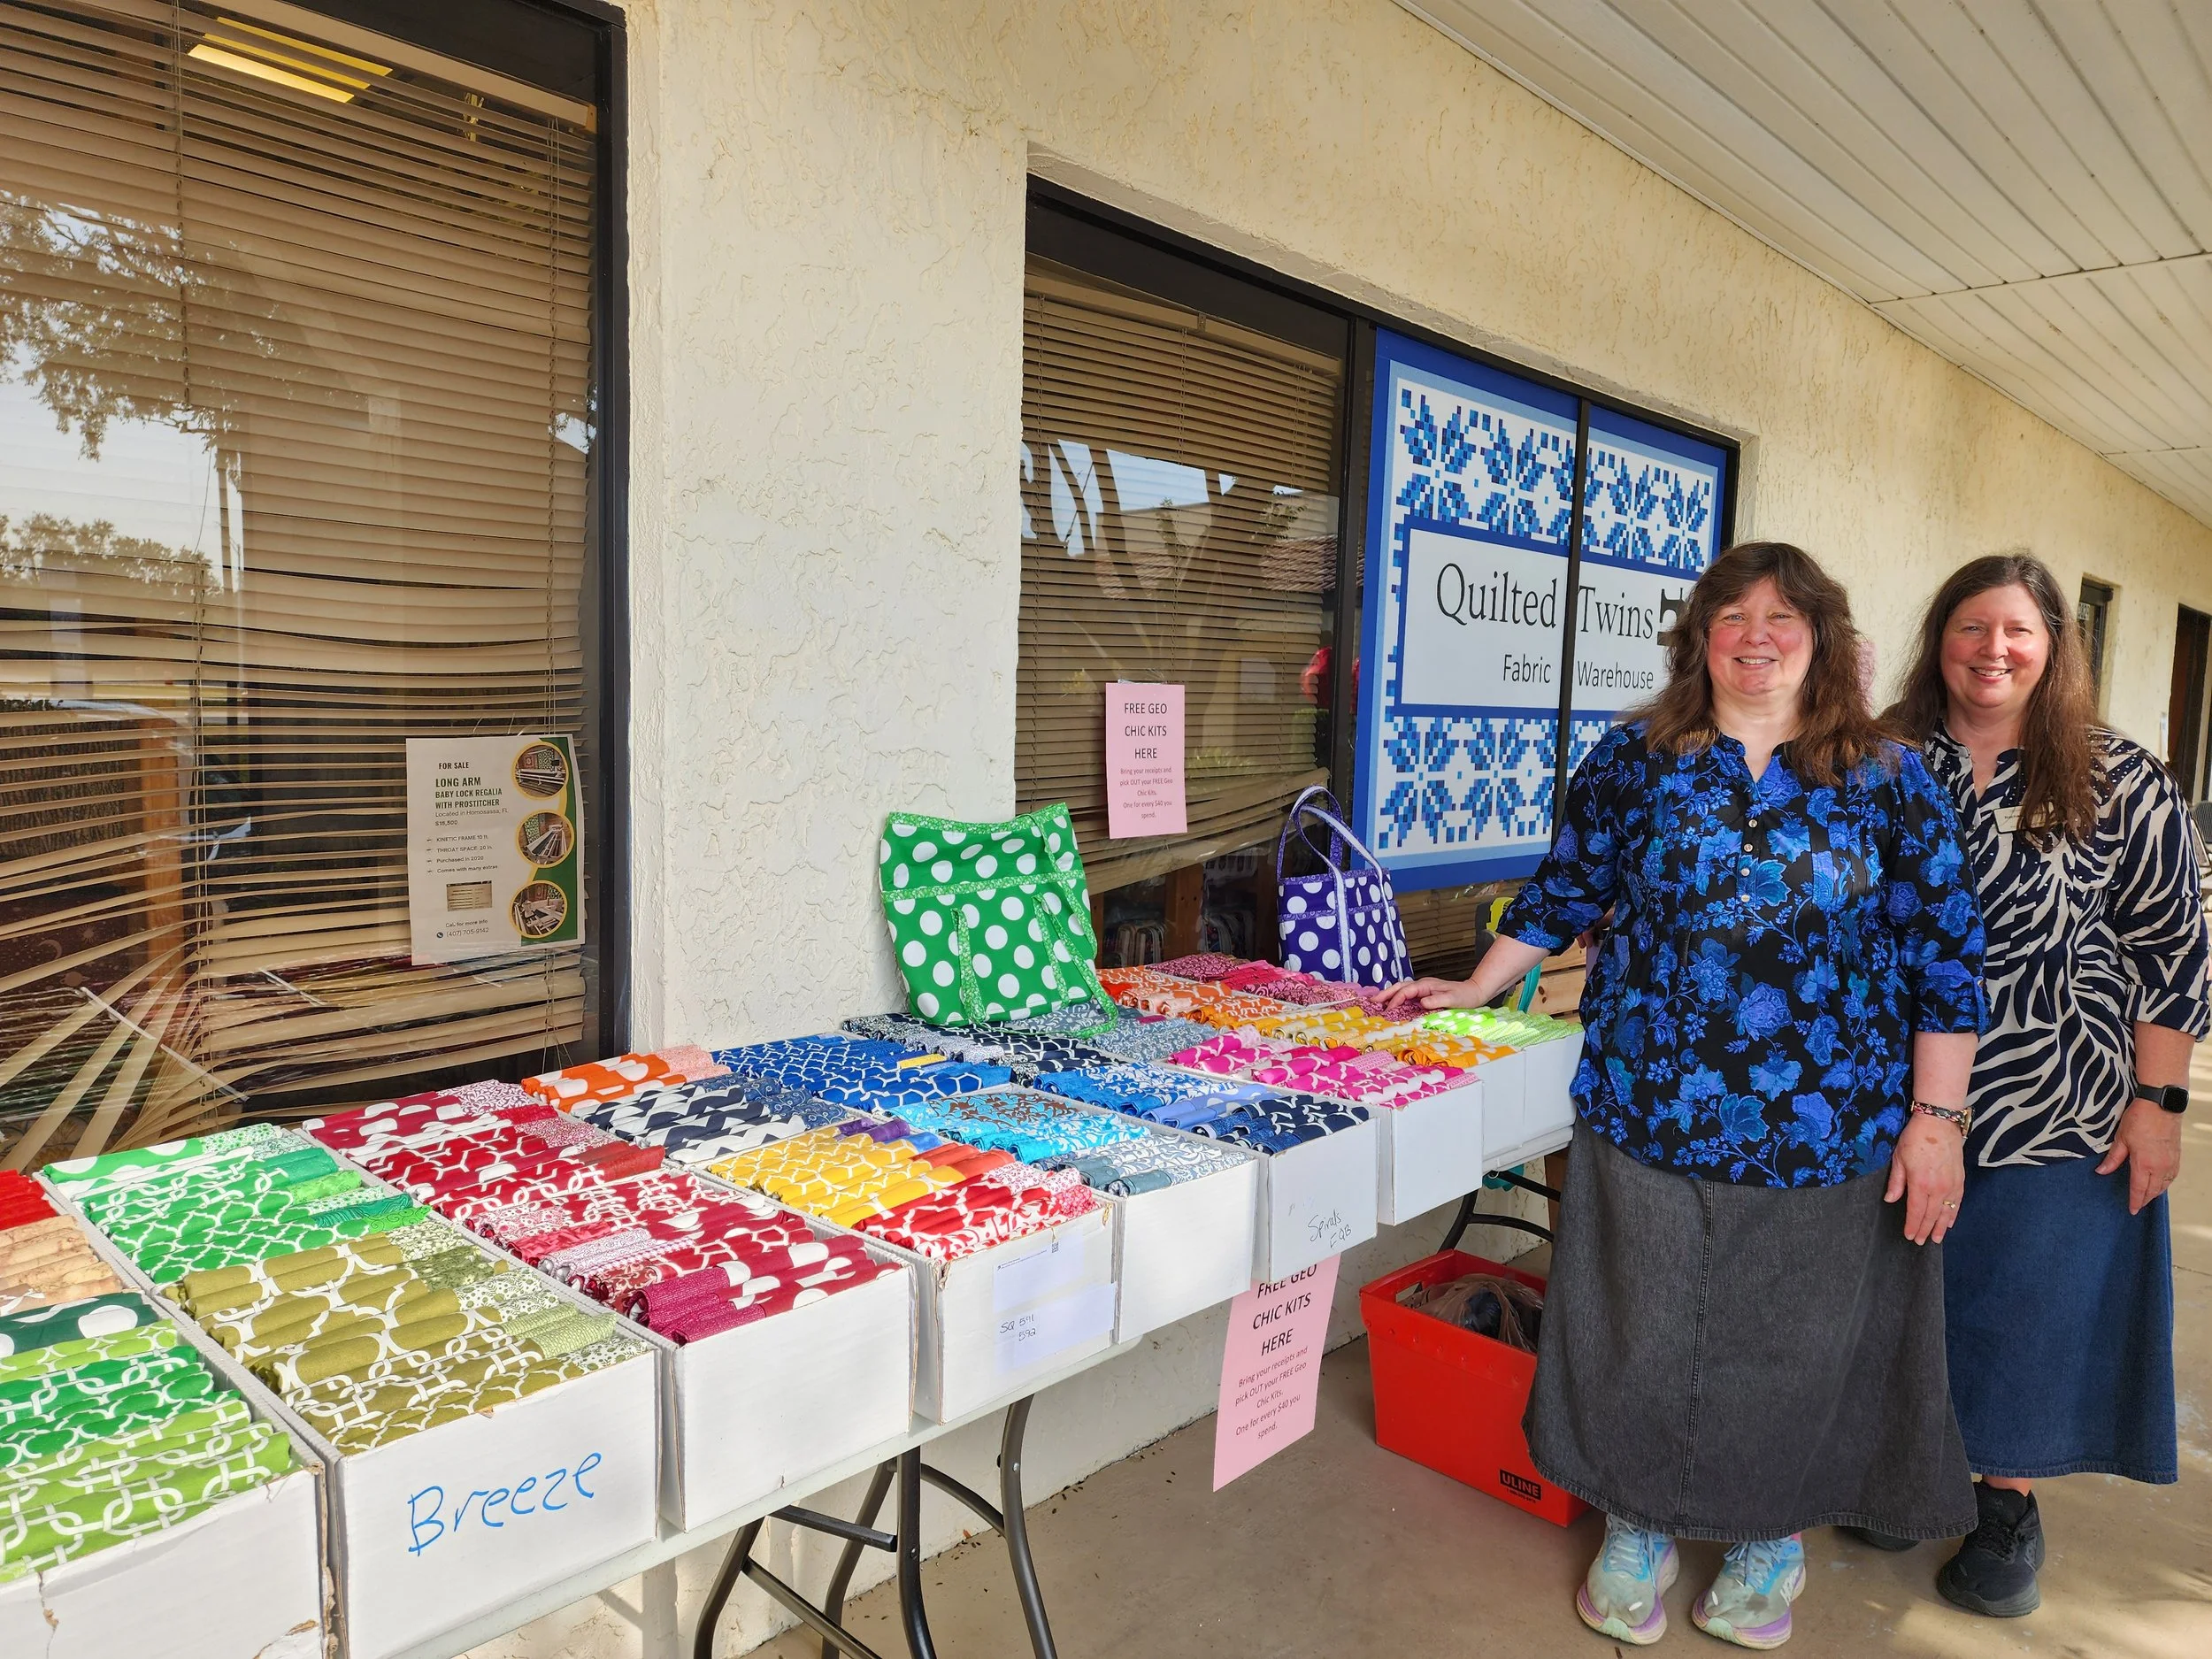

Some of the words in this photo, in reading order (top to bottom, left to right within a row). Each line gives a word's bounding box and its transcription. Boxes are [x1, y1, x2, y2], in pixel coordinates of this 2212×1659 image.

[1437, 563, 1557, 628] Quilted
[1578, 585, 1654, 639] Twins
[1503, 654, 1551, 683] Fabric
[1577, 660, 1654, 689] Warehouse
[1124, 703, 1146, 714] FREE
[1148, 703, 1168, 714] GEO
[1125, 726, 1146, 737] CHIC
[1148, 726, 1167, 737] KITS
[1134, 748, 1157, 759] HERE
[435, 778, 459, 787] LONG
[462, 776, 481, 787] ARM
[435, 790, 454, 799] BABY
[475, 787, 503, 796] REGALIA
[454, 798, 500, 808] PROSTITCHER
[1253, 1304, 1283, 1330] CHIC
[1285, 1292, 1311, 1316] KITS
[1261, 1328, 1294, 1356] HERE
[1238, 1373, 1256, 1387] Bring
[1256, 1366, 1271, 1380] your
[1271, 1354, 1295, 1371] receipts
[1295, 1346, 1308, 1357] and
[1235, 1392, 1248, 1407] pick
[1249, 1383, 1263, 1397] OUT
[1264, 1377, 1279, 1391] your
[1279, 1366, 1294, 1381] FREE
[1294, 1362, 1307, 1372] Geo
[1256, 1394, 1270, 1408] Chic
[1236, 1424, 1248, 1435] One
[1249, 1417, 1259, 1428] for
[1260, 1408, 1277, 1422] every
[1278, 1400, 1289, 1412] $40
[1289, 1394, 1301, 1407] you
[1502, 1472, 1539, 1497] ULINE
[407, 1452, 602, 1557] Breeze
